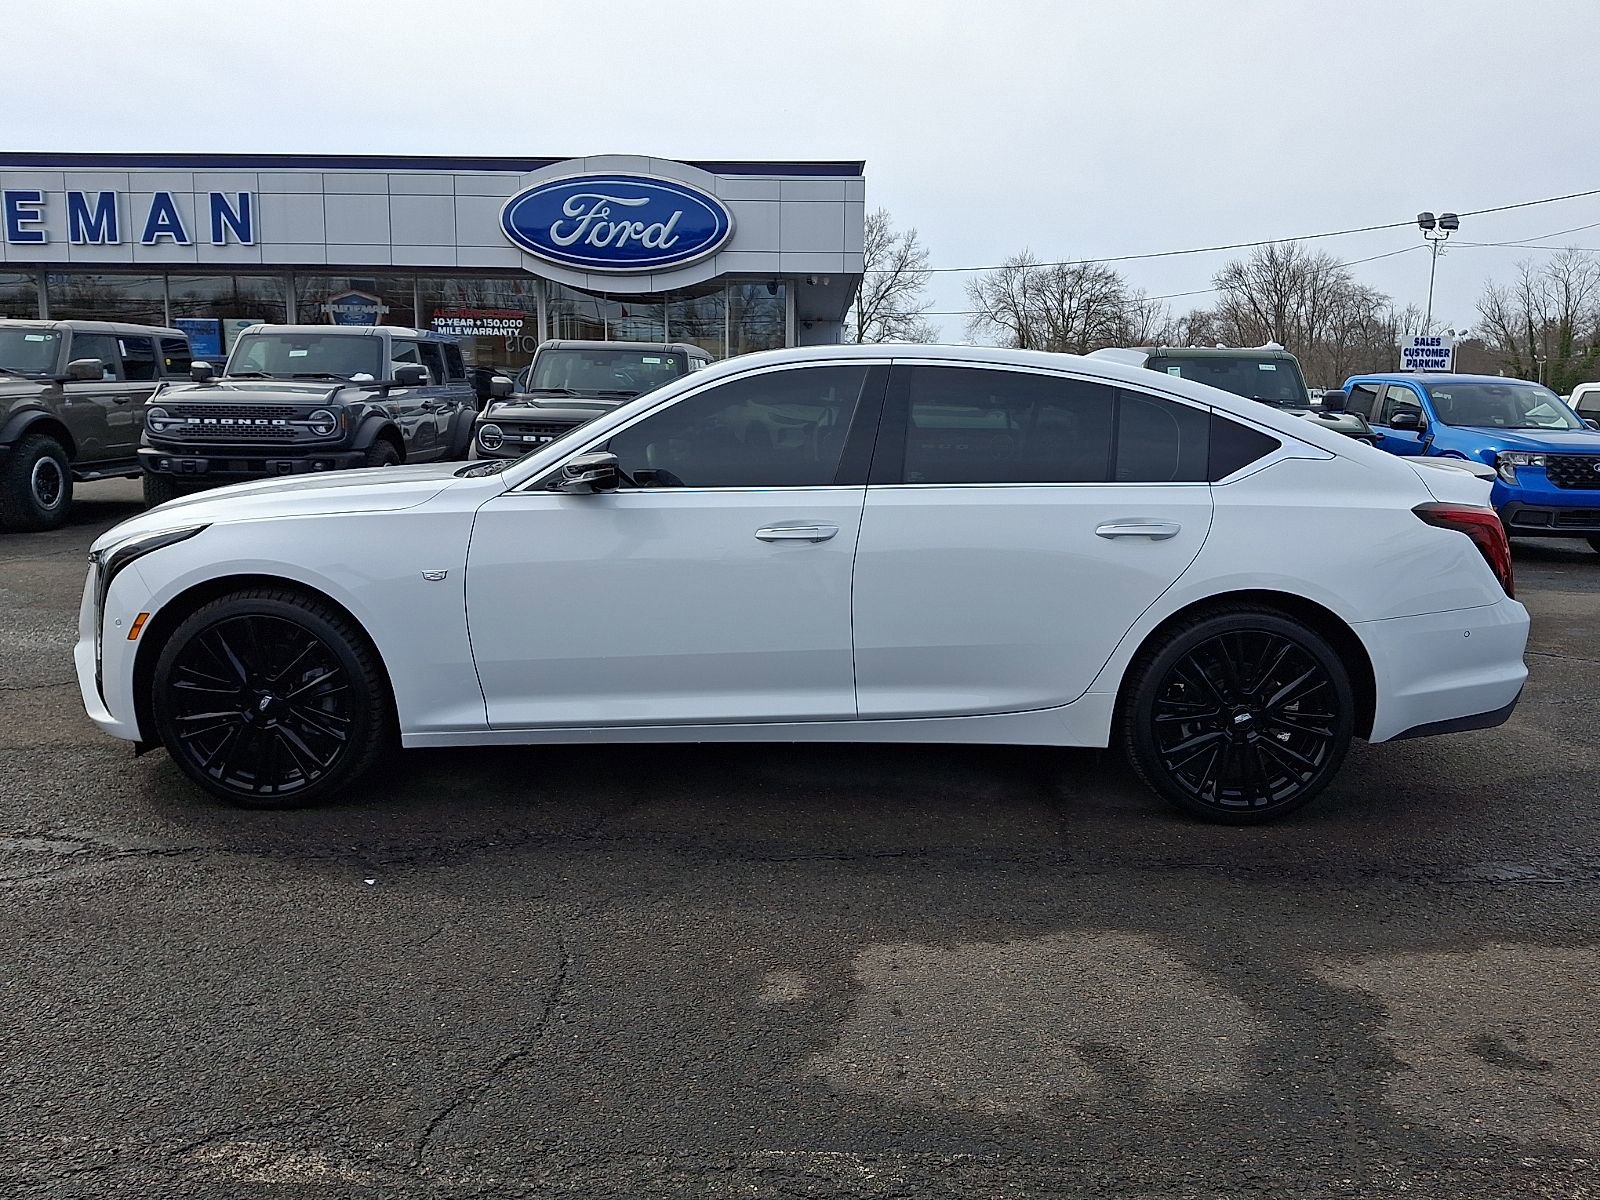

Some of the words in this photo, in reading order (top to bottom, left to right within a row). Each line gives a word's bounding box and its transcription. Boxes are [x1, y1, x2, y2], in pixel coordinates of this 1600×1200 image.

[2, 189, 256, 246] EMAN
[550, 193, 683, 250] Ford
[483, 319, 523, 328] 150,000
[437, 326, 462, 335] MILE
[463, 328, 520, 337] WARRANTY
[1413, 337, 1441, 346] SALES
[1403, 347, 1450, 358] CUSTOMER
[1406, 358, 1446, 368] PARKING
